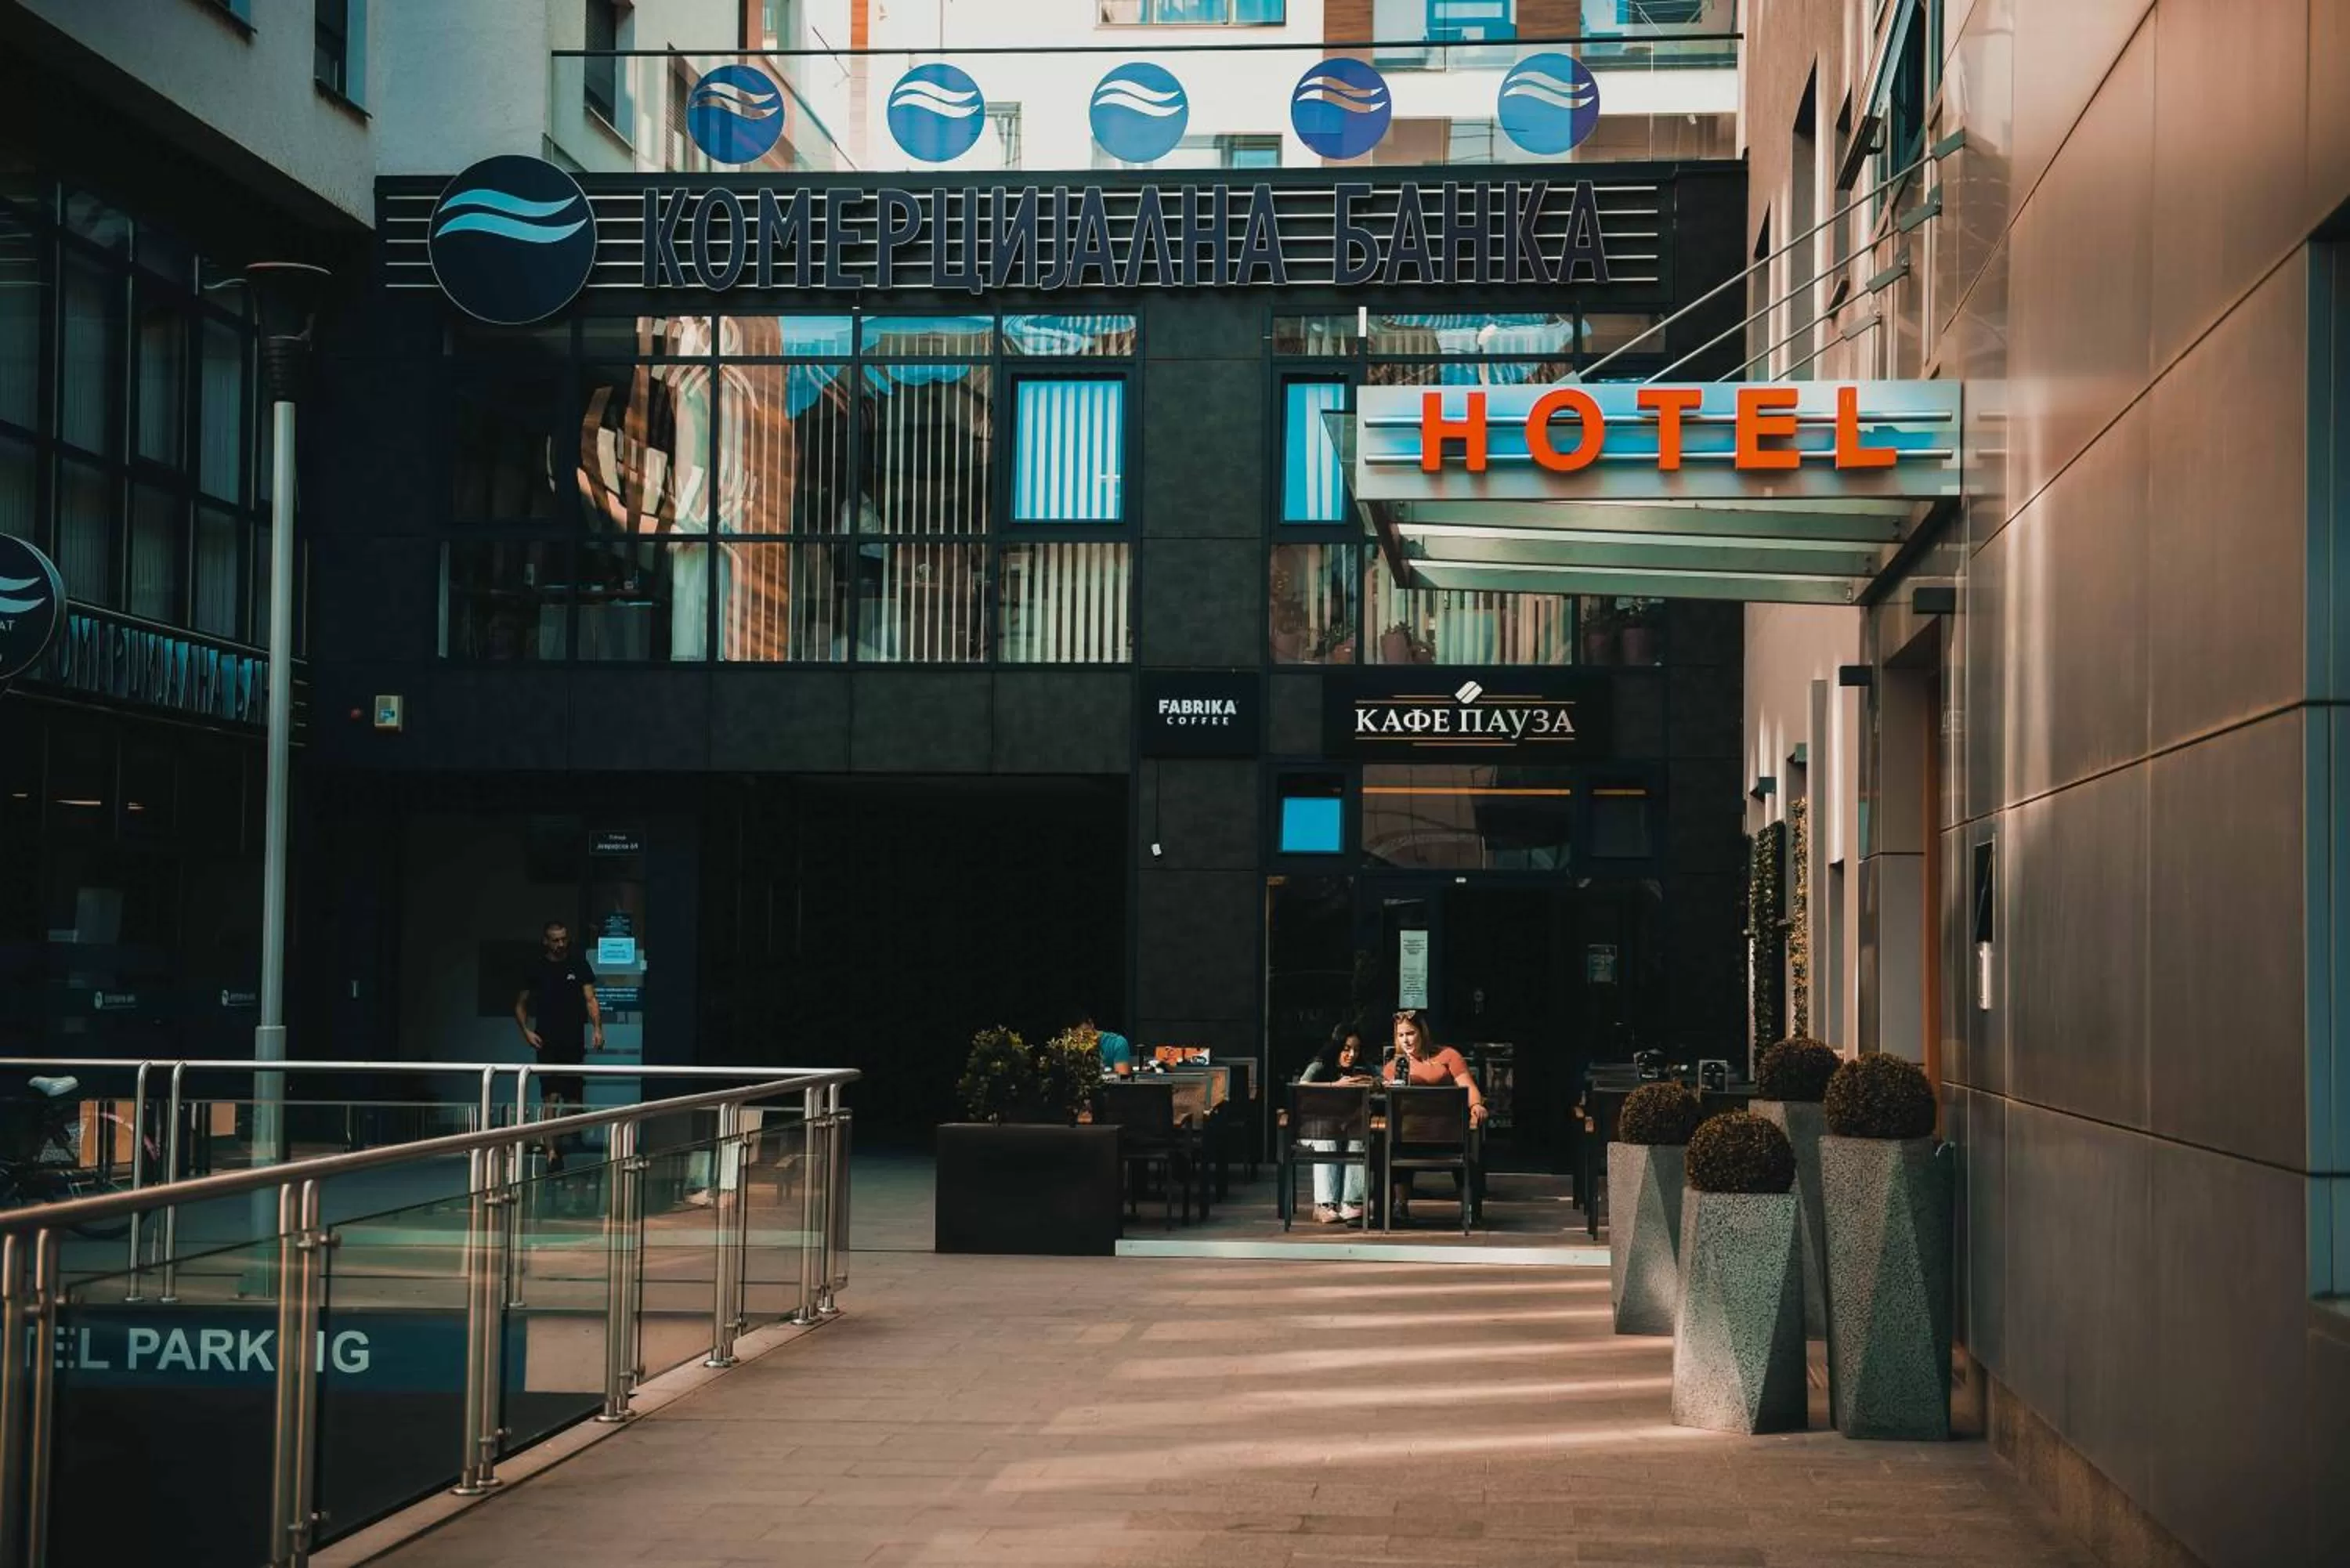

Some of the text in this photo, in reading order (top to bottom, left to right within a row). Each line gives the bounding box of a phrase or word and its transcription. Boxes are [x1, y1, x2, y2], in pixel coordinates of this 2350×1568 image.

[641, 180, 1611, 295] КОМЕРЦИЈАЛНА БАНКА
[1421, 387, 1897, 472] HOTEL
[1159, 699, 1237, 714] FABRIKA
[1166, 717, 1229, 726] COFFEE
[1355, 708, 1575, 738] КАФЕ ПАУЗА
[127, 1327, 370, 1374] PARKG
